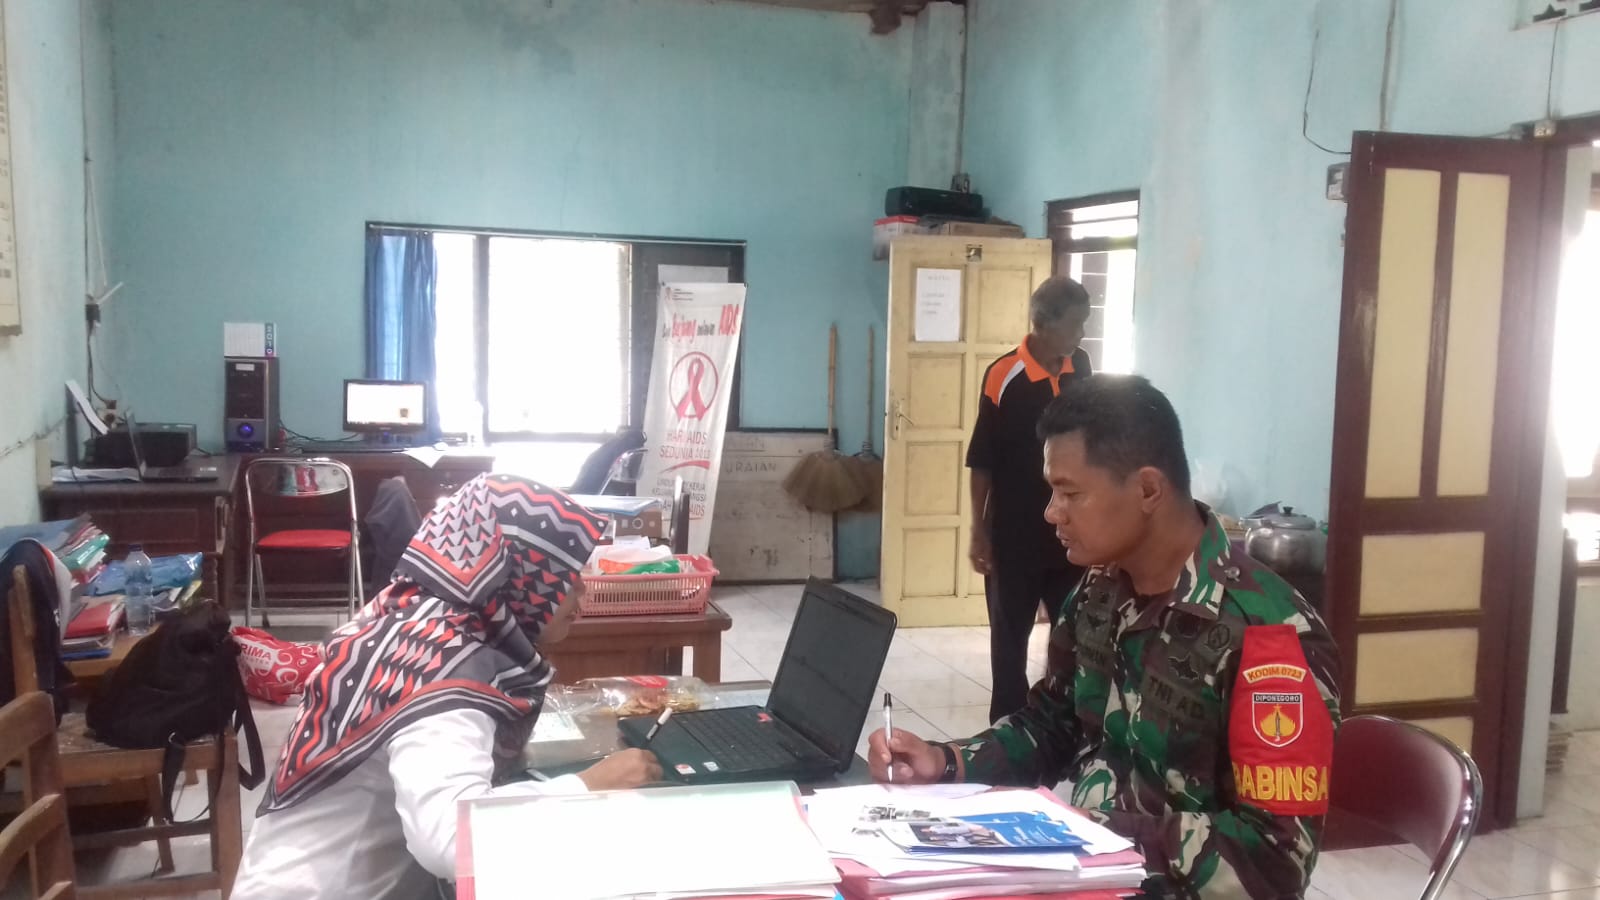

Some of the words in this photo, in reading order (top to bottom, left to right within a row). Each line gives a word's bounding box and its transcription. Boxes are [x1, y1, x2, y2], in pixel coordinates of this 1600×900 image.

[719, 303, 740, 336] AIDS
[687, 431, 708, 445] AIDS
[659, 445, 693, 460] SEDUNIA
[725, 462, 777, 474] URAIAN
[240, 643, 272, 661] RIMA
[1247, 666, 1281, 681] KODIM
